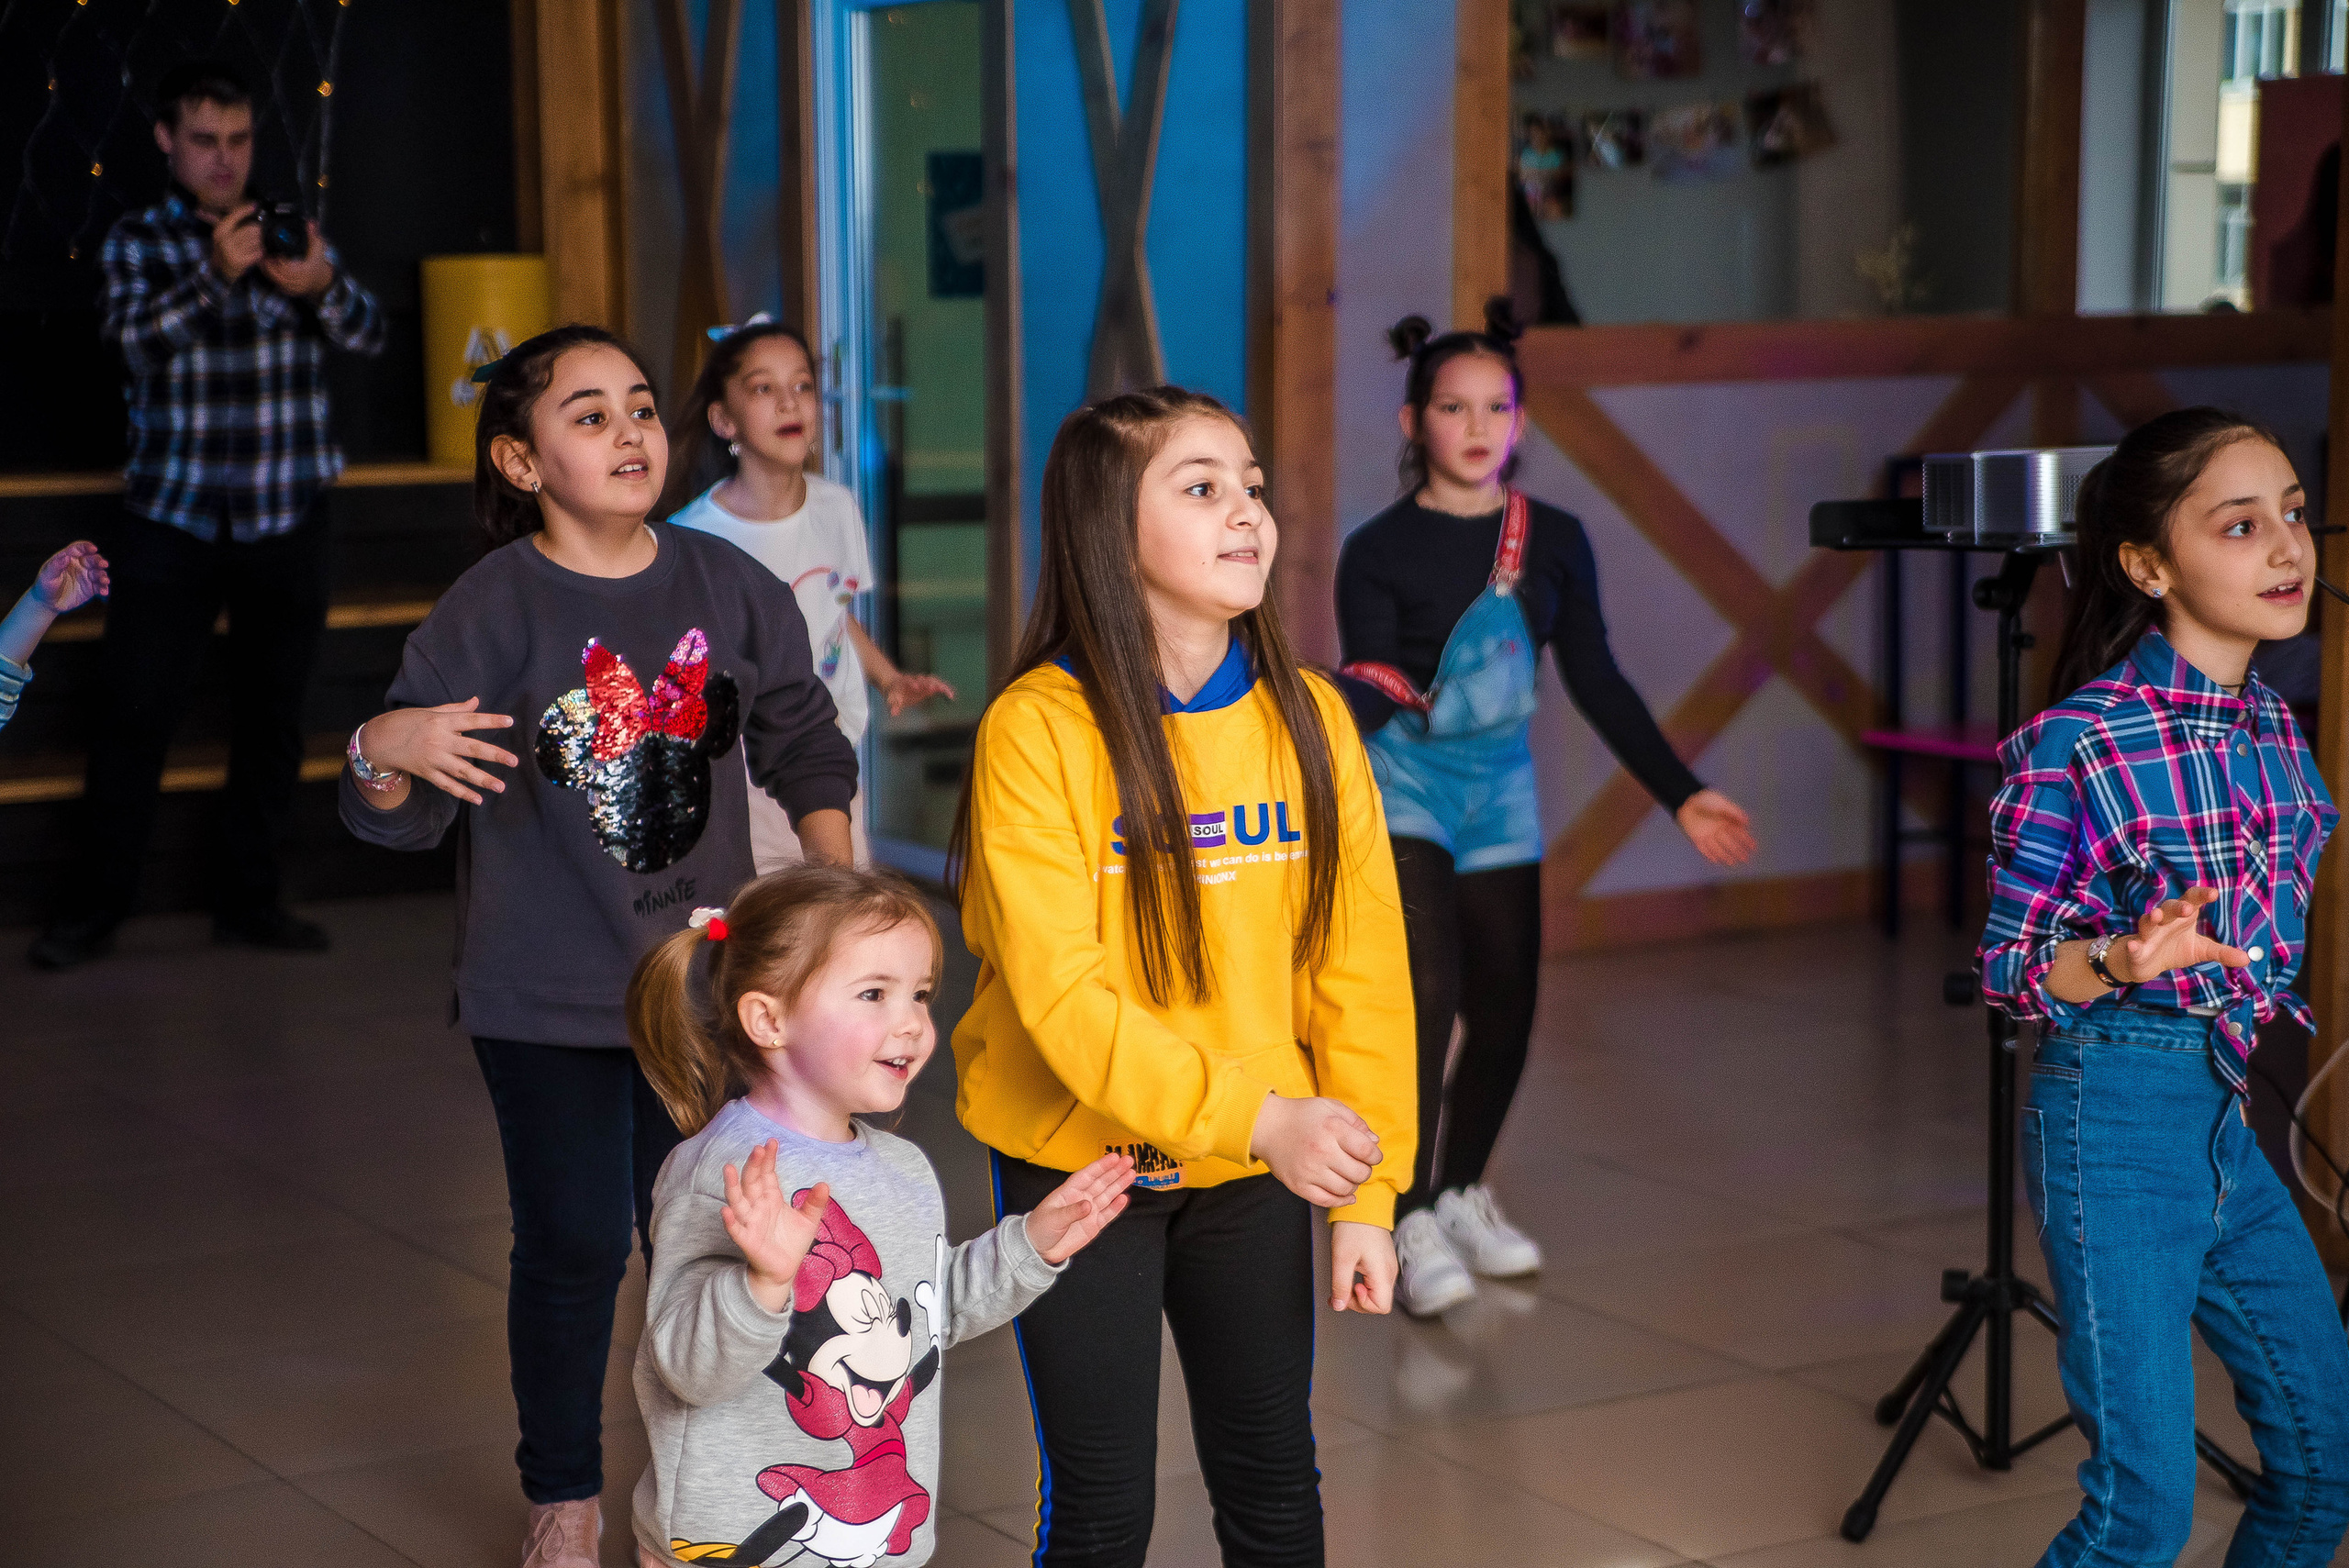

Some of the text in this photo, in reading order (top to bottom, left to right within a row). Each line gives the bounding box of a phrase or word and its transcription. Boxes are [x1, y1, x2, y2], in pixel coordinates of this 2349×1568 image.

[1193, 823, 1224, 836] SOUL
[1209, 858, 1220, 868] we
[1222, 855, 1242, 865] can
[1245, 852, 1259, 863] do
[1262, 851, 1271, 862] is
[1275, 851, 1287, 862] be
[633, 877, 696, 917] MINNIE
